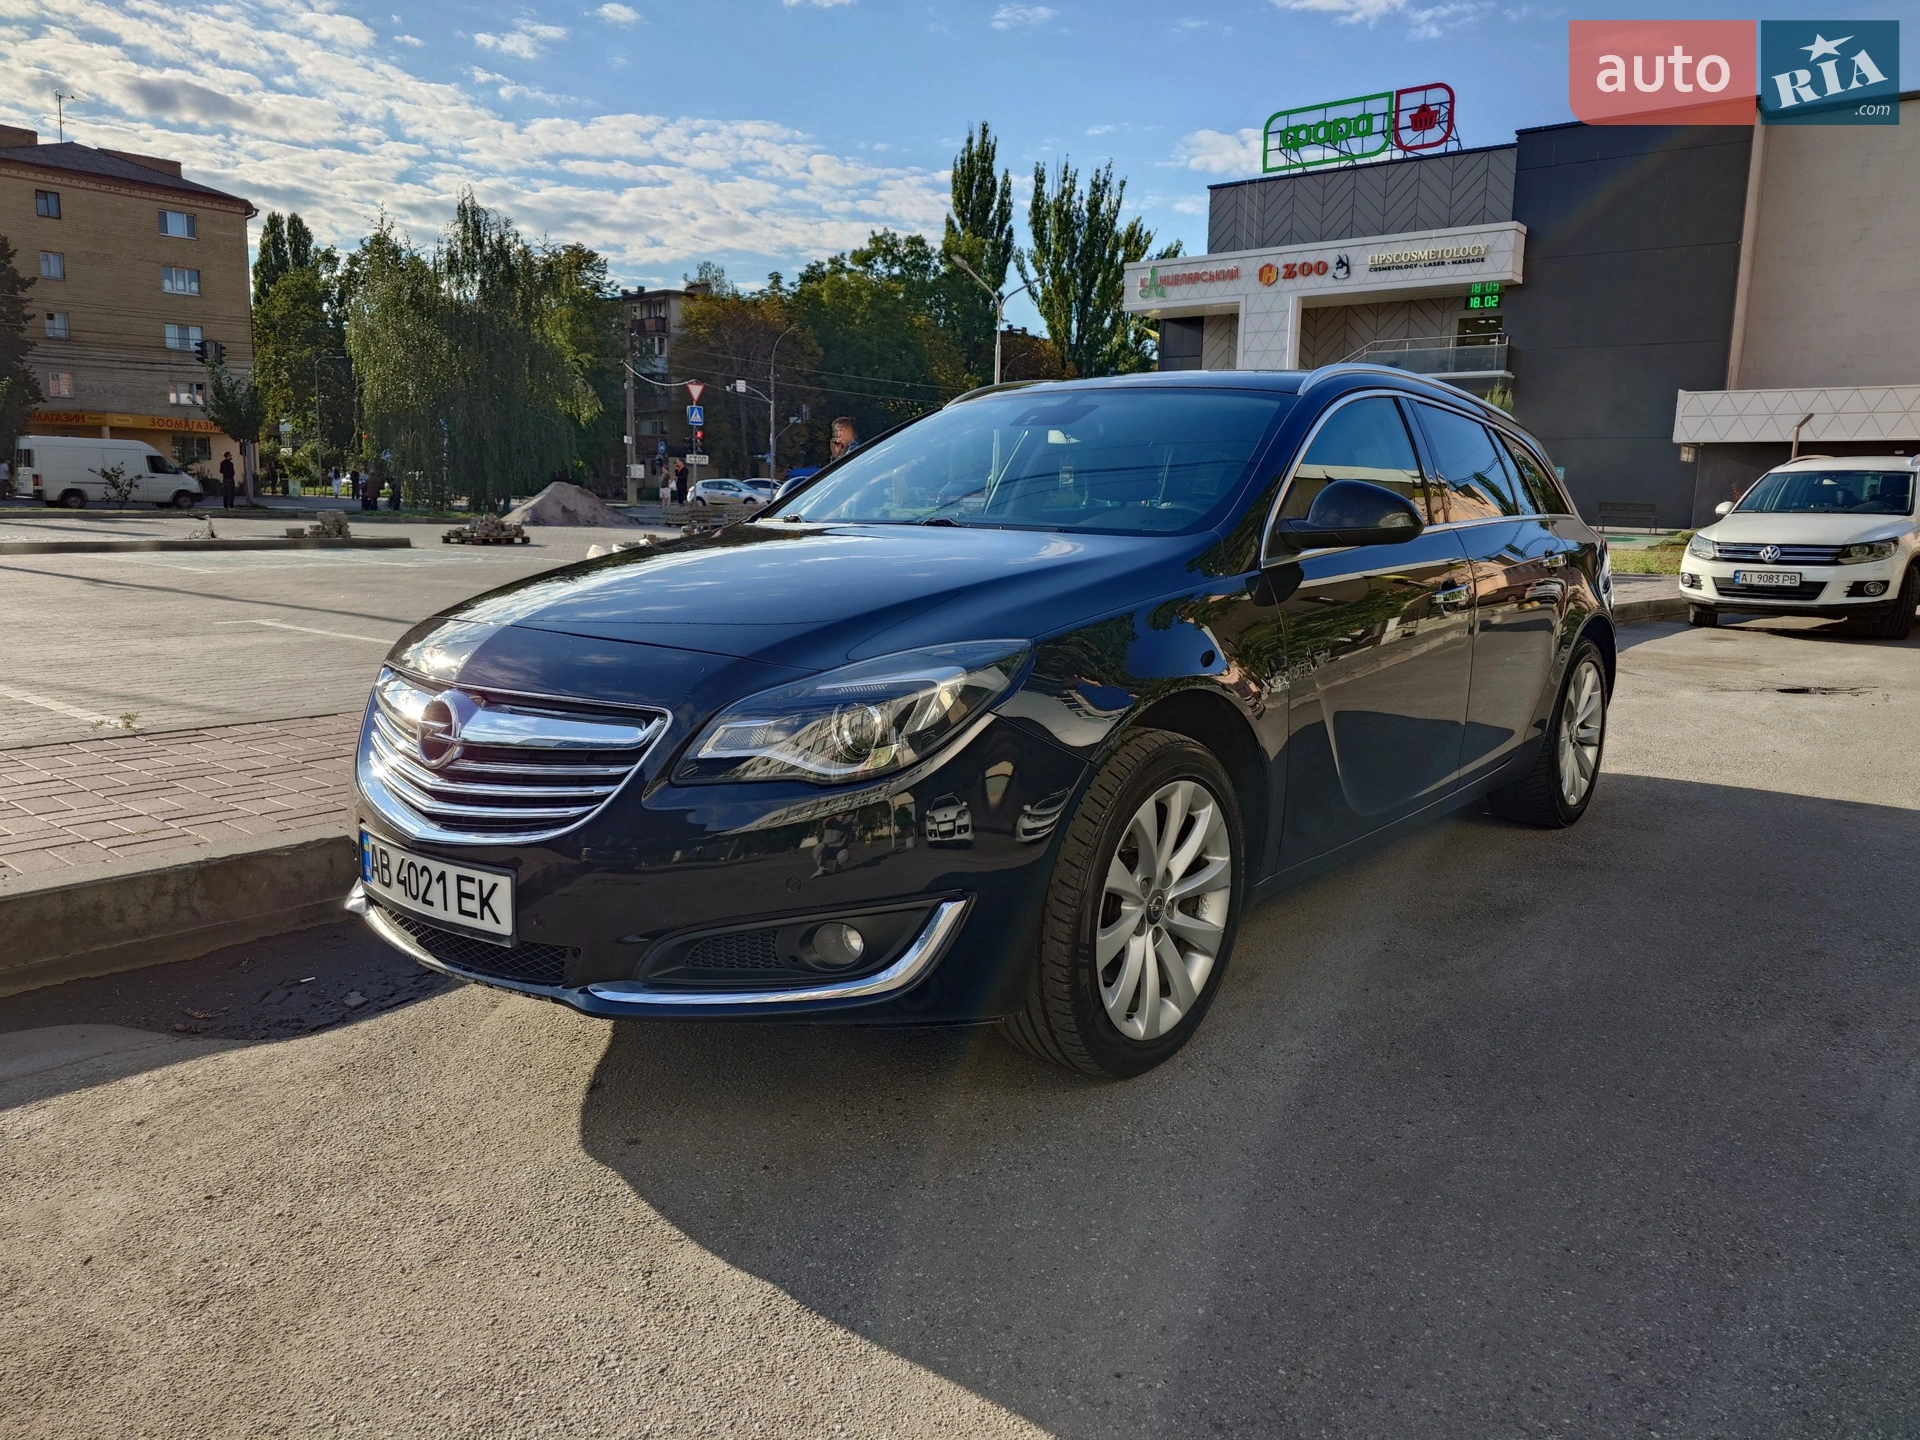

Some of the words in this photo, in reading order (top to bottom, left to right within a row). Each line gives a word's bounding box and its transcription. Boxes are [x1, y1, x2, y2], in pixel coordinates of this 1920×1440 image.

[1281, 112, 1374, 152] фора
[1367, 244, 1488, 266] LIPSCOSMETOLOGY
[1368, 263, 1418, 273] COSMETOLOGY
[1424, 260, 1446, 268] LASER
[1451, 256, 1486, 266] MASSAGE
[1282, 260, 1329, 280] ZOO
[1741, 574, 1753, 582] AI
[1757, 574, 1780, 584] 9083
[1782, 575, 1797, 585] PB
[371, 842, 392, 889] AB
[396, 856, 448, 912] 4021
[456, 873, 501, 925] EK
